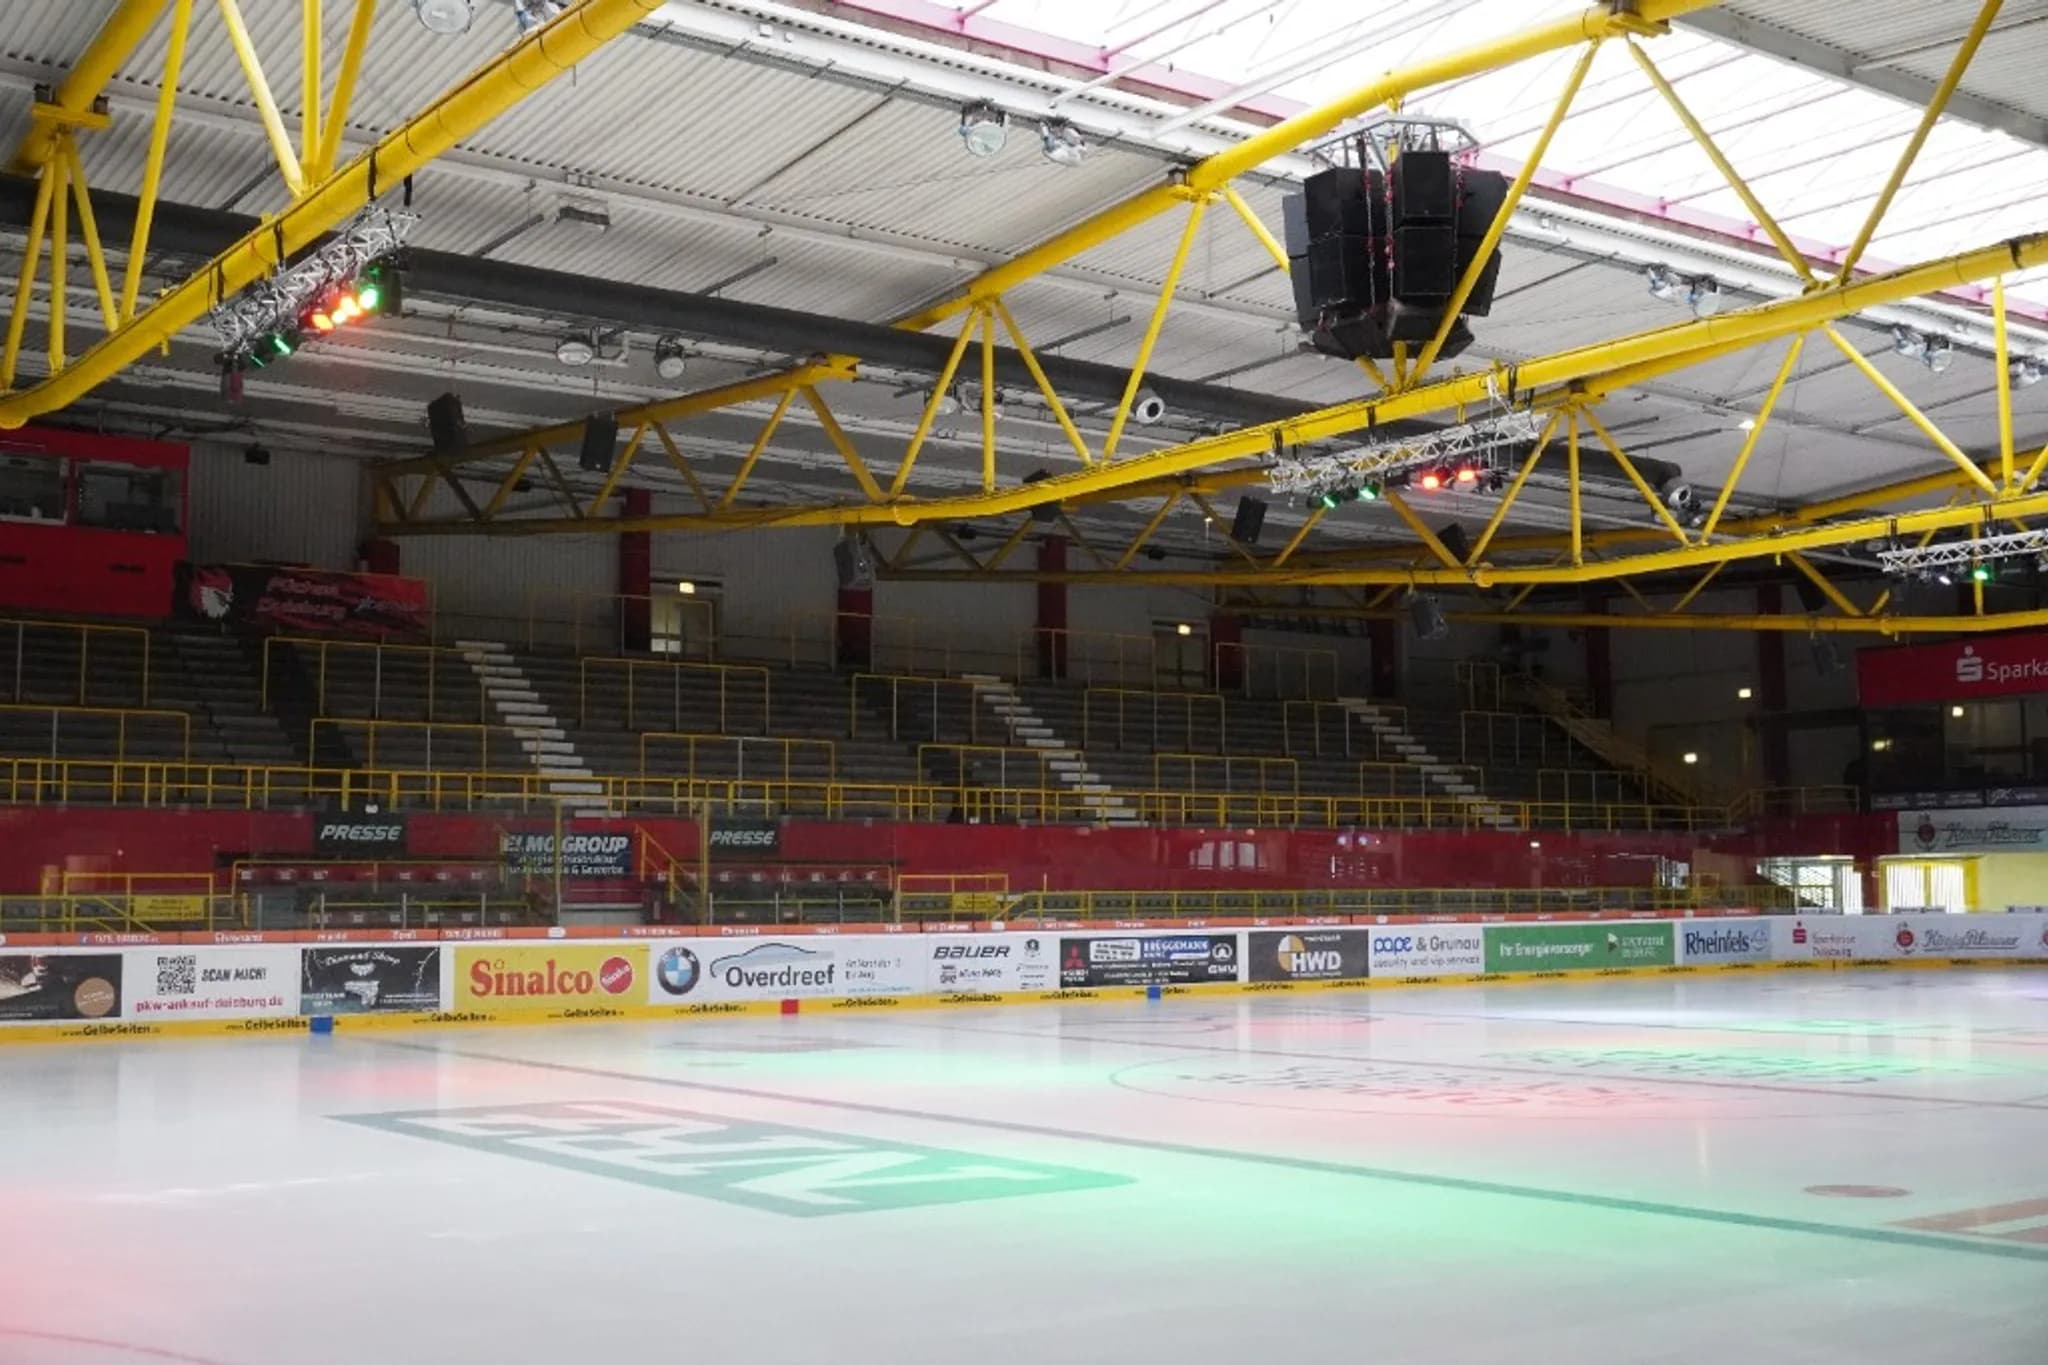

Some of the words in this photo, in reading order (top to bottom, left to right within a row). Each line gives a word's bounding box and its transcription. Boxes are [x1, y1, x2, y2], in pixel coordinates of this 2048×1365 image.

[320, 824, 403, 841] PRESSE
[710, 830, 777, 846] PRESSE
[933, 944, 1011, 960] BAUER
[1373, 936, 1413, 956] pape
[1416, 937, 1427, 952] &
[1685, 928, 1751, 956] Rheinfels
[1290, 950, 1342, 973] HWD
[201, 968, 231, 982] SCAN
[234, 967, 267, 981] MICH!
[470, 958, 594, 997] Sinalco
[725, 964, 835, 989] Overdreef
